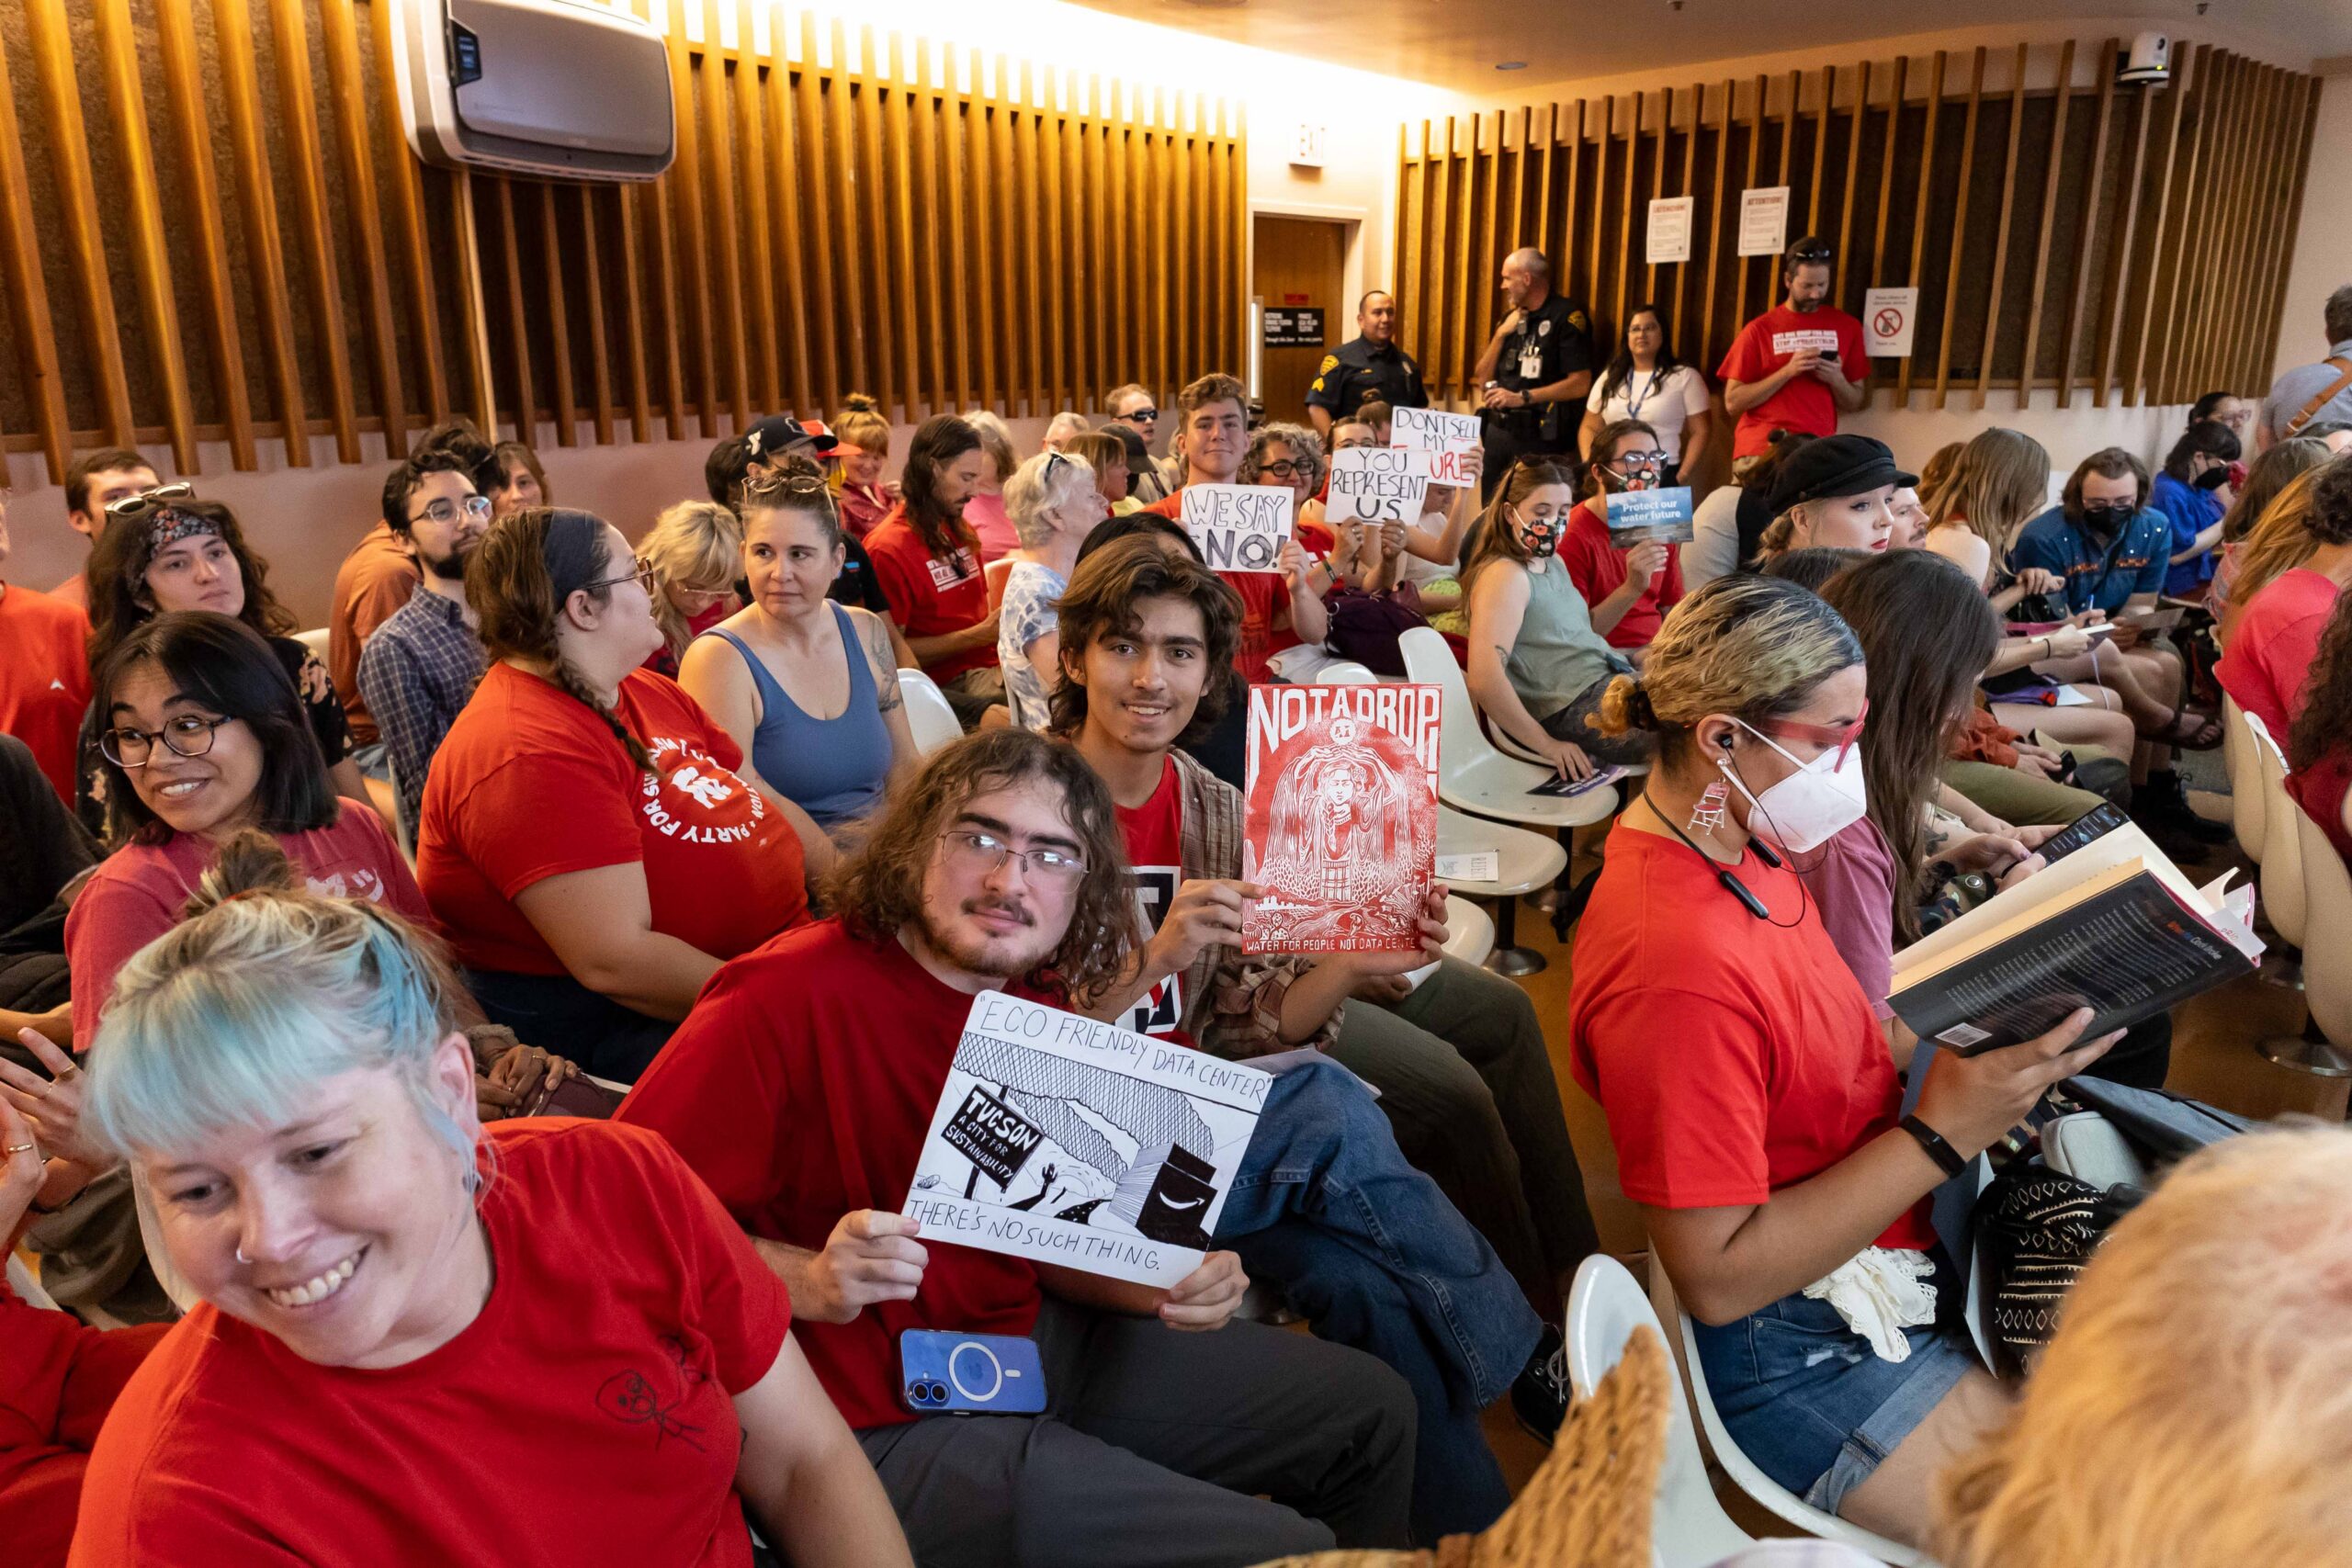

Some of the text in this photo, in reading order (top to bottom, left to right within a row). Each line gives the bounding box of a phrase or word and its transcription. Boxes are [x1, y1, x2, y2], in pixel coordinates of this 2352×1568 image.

[1424, 434, 1449, 452] MY
[1451, 418, 1478, 438] SELL
[1358, 449, 1408, 473] YOU
[1332, 468, 1429, 501] REPRESENT
[1184, 489, 1287, 534] WE SAY
[1355, 497, 1402, 521] US
[1621, 511, 1681, 523] water future
[1623, 501, 1679, 513] Protect our
[1206, 528, 1289, 570] NO!
[1249, 688, 1329, 802] NOT
[1330, 688, 1351, 719] A
[643, 798, 751, 843] PARTY FOR
[1246, 937, 1416, 952] WATER FOR PEOPLE NOT DATA CENTE
[1055, 1017, 1149, 1070] FRIENDLY
[1152, 1049, 1195, 1077] DATA
[958, 1115, 1009, 1156] A CITY FOR
[966, 1089, 1040, 1152] TUCSON
[945, 1124, 1014, 1179] SUSTAINABILITY
[910, 1200, 1160, 1271] THERE'S NO SUCH THING.
